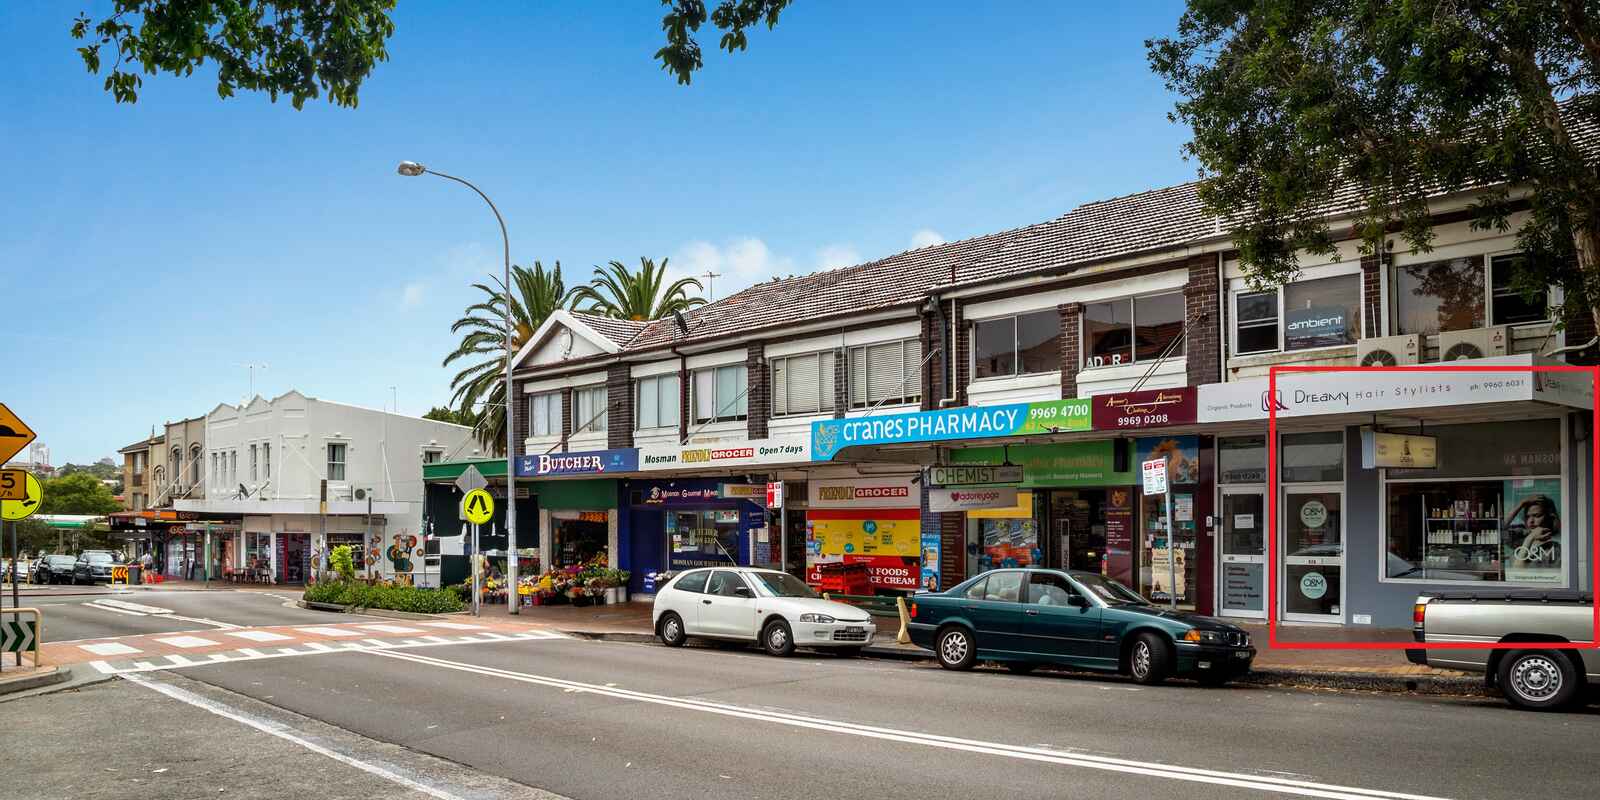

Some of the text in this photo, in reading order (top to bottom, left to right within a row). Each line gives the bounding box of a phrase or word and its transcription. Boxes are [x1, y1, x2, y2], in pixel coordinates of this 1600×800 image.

[1287, 316, 1343, 330] ambient
[1356, 390, 1385, 399] Hair
[1394, 384, 1451, 396] Stylists
[1483, 381, 1503, 389] 9960
[1031, 404, 1088, 419] 9969 4700
[843, 419, 904, 441] cranes
[907, 408, 1018, 437] PHARMACY
[1118, 414, 1168, 426] 9969 0208
[644, 454, 677, 464] Mosman
[712, 449, 753, 459] GROCER
[759, 446, 779, 455] Open
[784, 444, 803, 454] days
[936, 468, 997, 483] CHEMIST
[856, 487, 907, 497] GROCER
[1514, 544, 1554, 561] O&M
[876, 568, 908, 576] FOODS
[883, 577, 915, 585] CREAM
[1303, 579, 1324, 588] O&M
